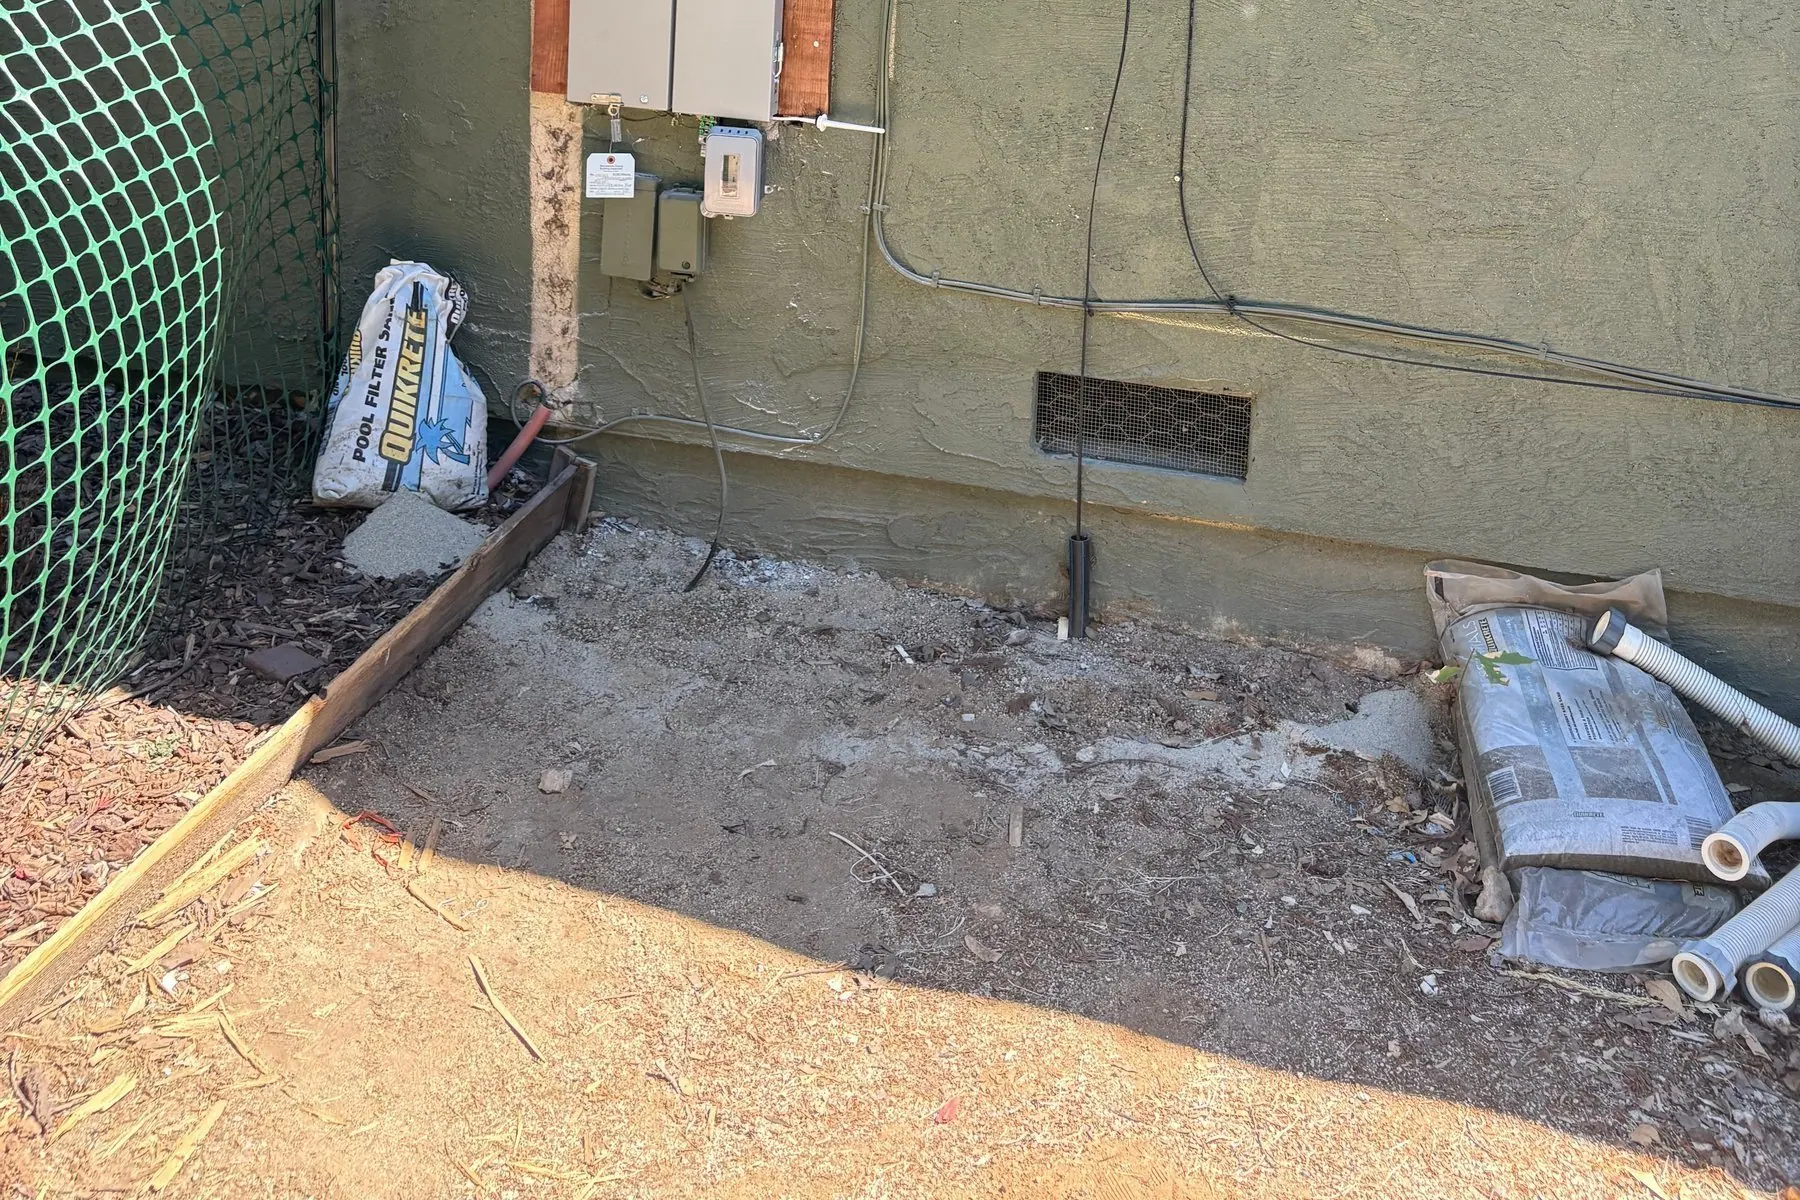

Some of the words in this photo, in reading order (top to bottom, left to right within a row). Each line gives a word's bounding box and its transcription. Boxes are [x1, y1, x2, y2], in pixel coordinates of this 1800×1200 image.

[352, 413, 375, 462] POOL
[365, 345, 388, 408] FILTER
[380, 308, 427, 463] QUIKRETE
